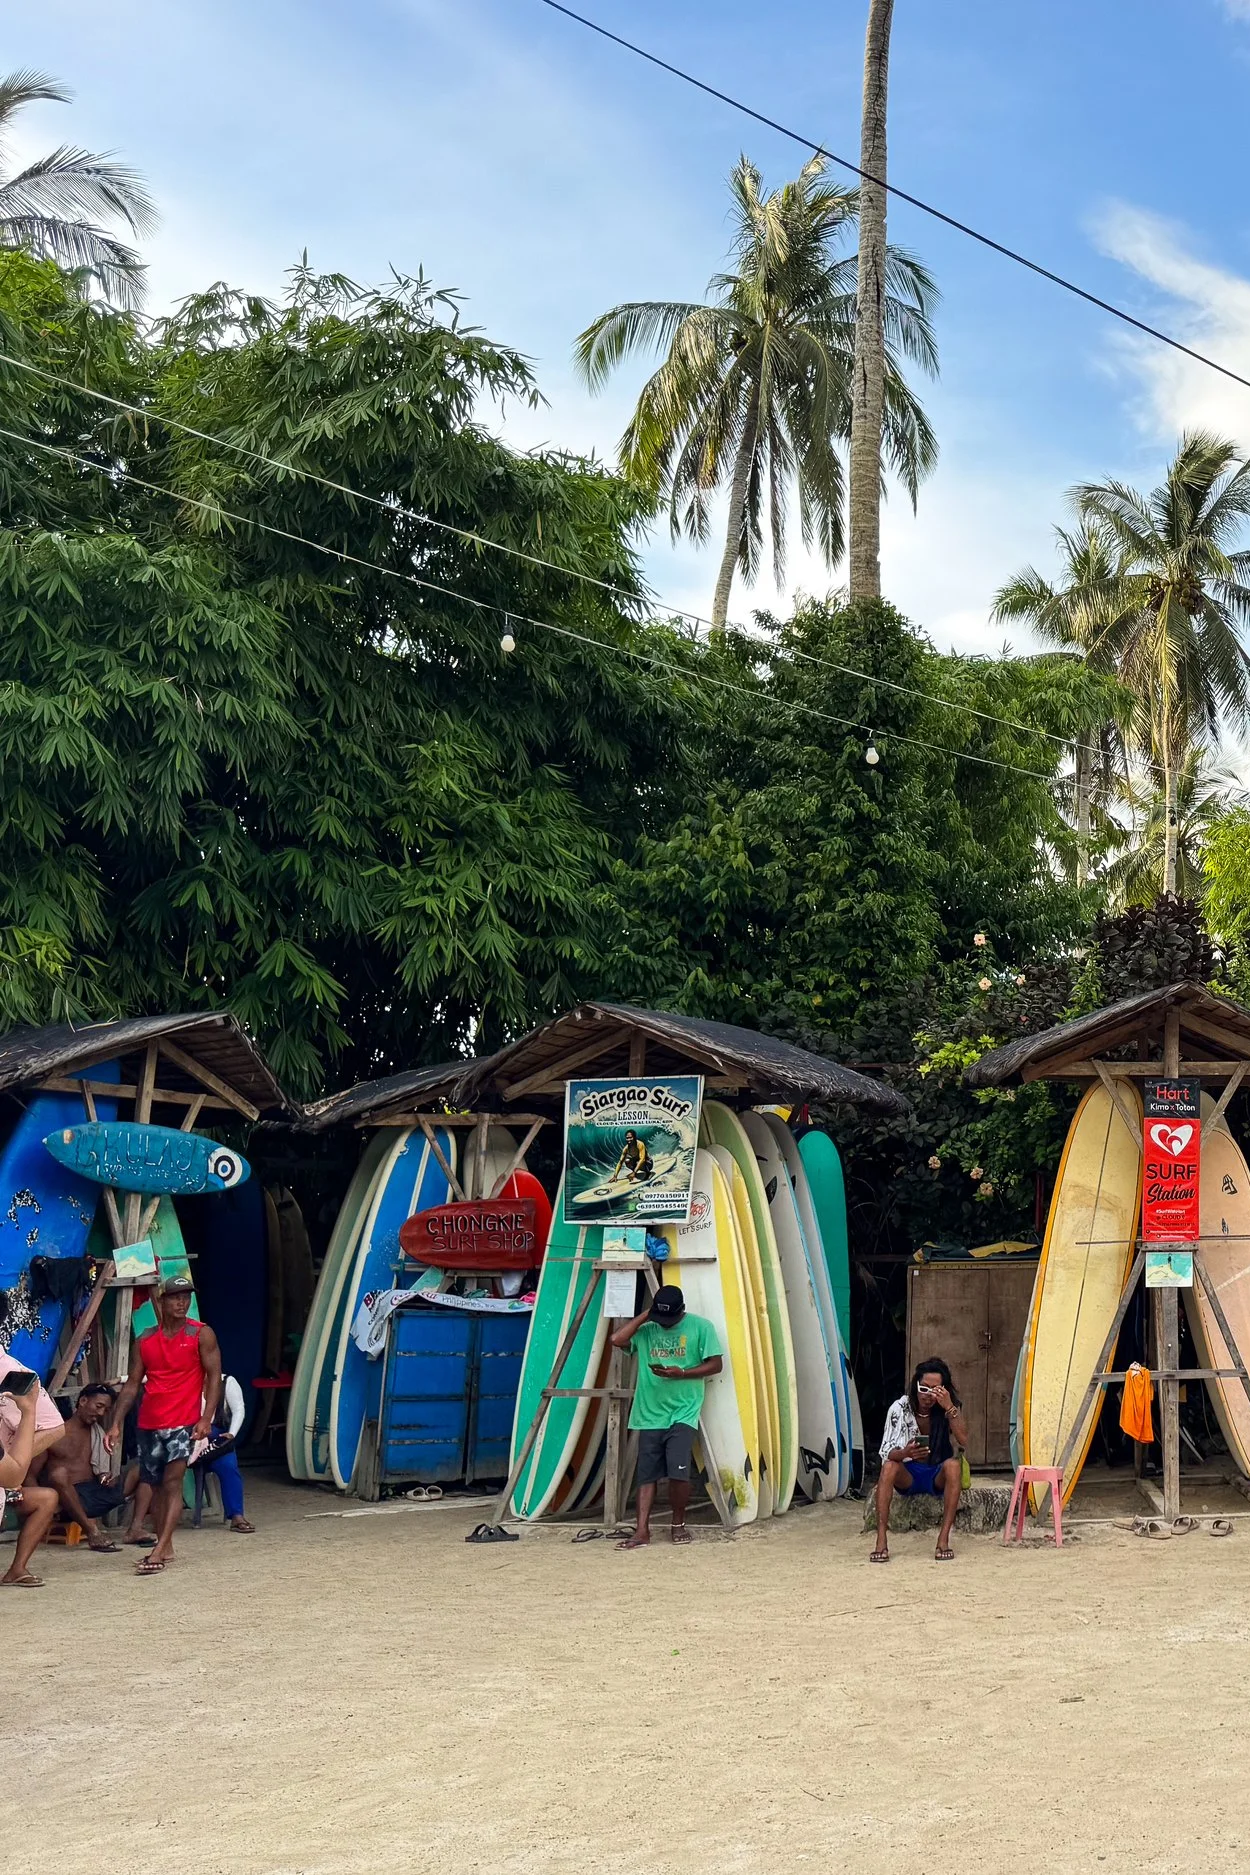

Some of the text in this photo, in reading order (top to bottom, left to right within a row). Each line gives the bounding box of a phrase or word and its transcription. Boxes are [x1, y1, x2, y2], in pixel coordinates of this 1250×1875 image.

[582, 1087, 690, 1118] Siargao Surf
[1156, 1086, 1189, 1100] Hart
[618, 1111, 649, 1120] LESSON
[1150, 1103, 1169, 1111] Kimo
[1175, 1103, 1196, 1111] Toton
[1146, 1163, 1197, 1180] SURF
[1146, 1183, 1195, 1204] Station
[427, 1213, 525, 1236] CHONGKIE
[432, 1230, 535, 1252] SURF SHOP
